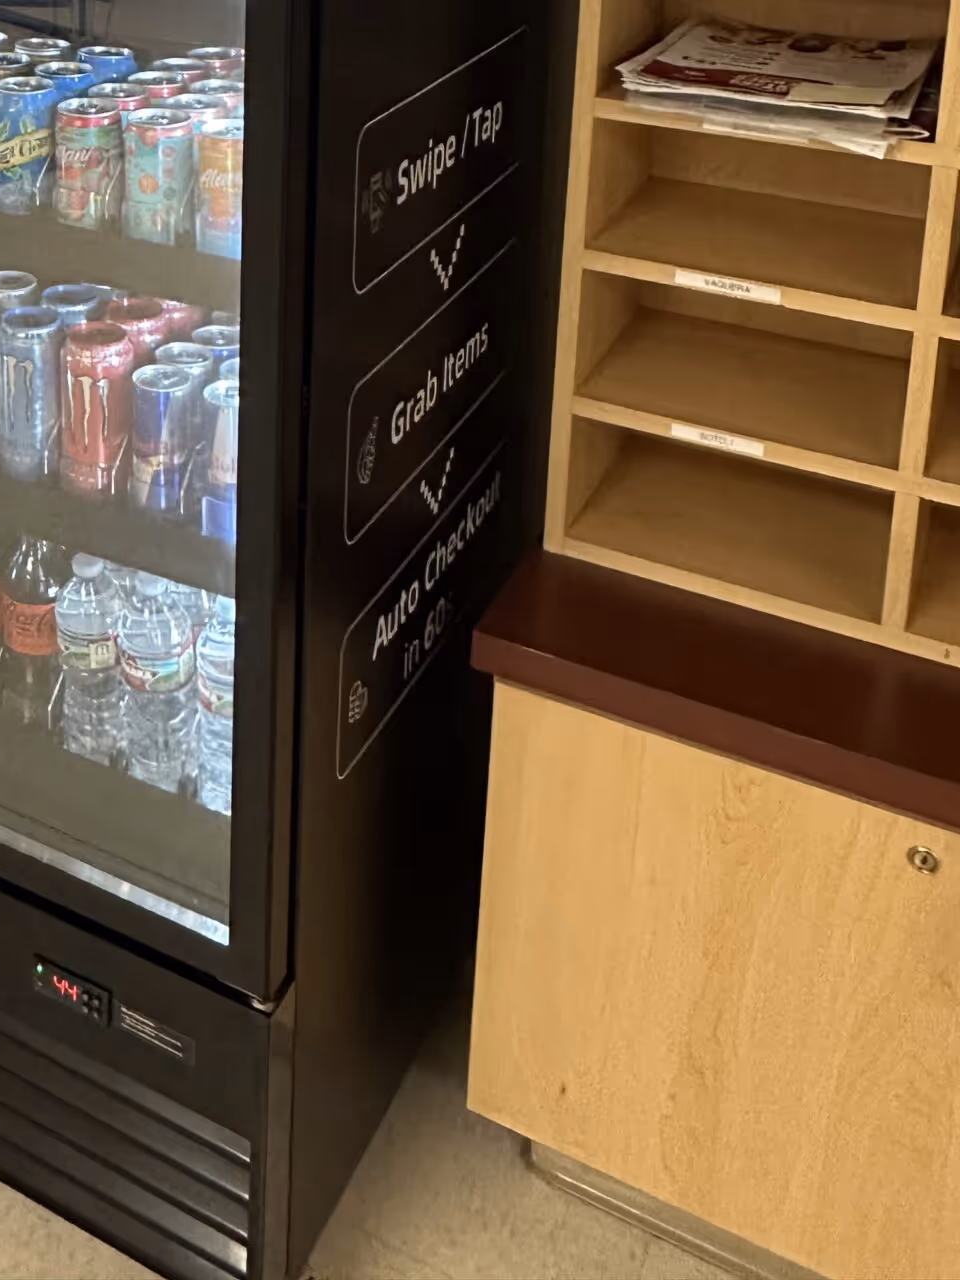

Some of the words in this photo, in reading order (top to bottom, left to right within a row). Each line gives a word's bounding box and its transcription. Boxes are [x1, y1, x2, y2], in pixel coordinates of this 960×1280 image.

[397, 134, 457, 205] Swipe
[472, 100, 503, 147] Tap
[391, 370, 438, 445] Grab
[442, 322, 489, 393] Items
[372, 585, 419, 662] Auto
[424, 470, 502, 592] Checkout
[403, 638, 420, 681] in
